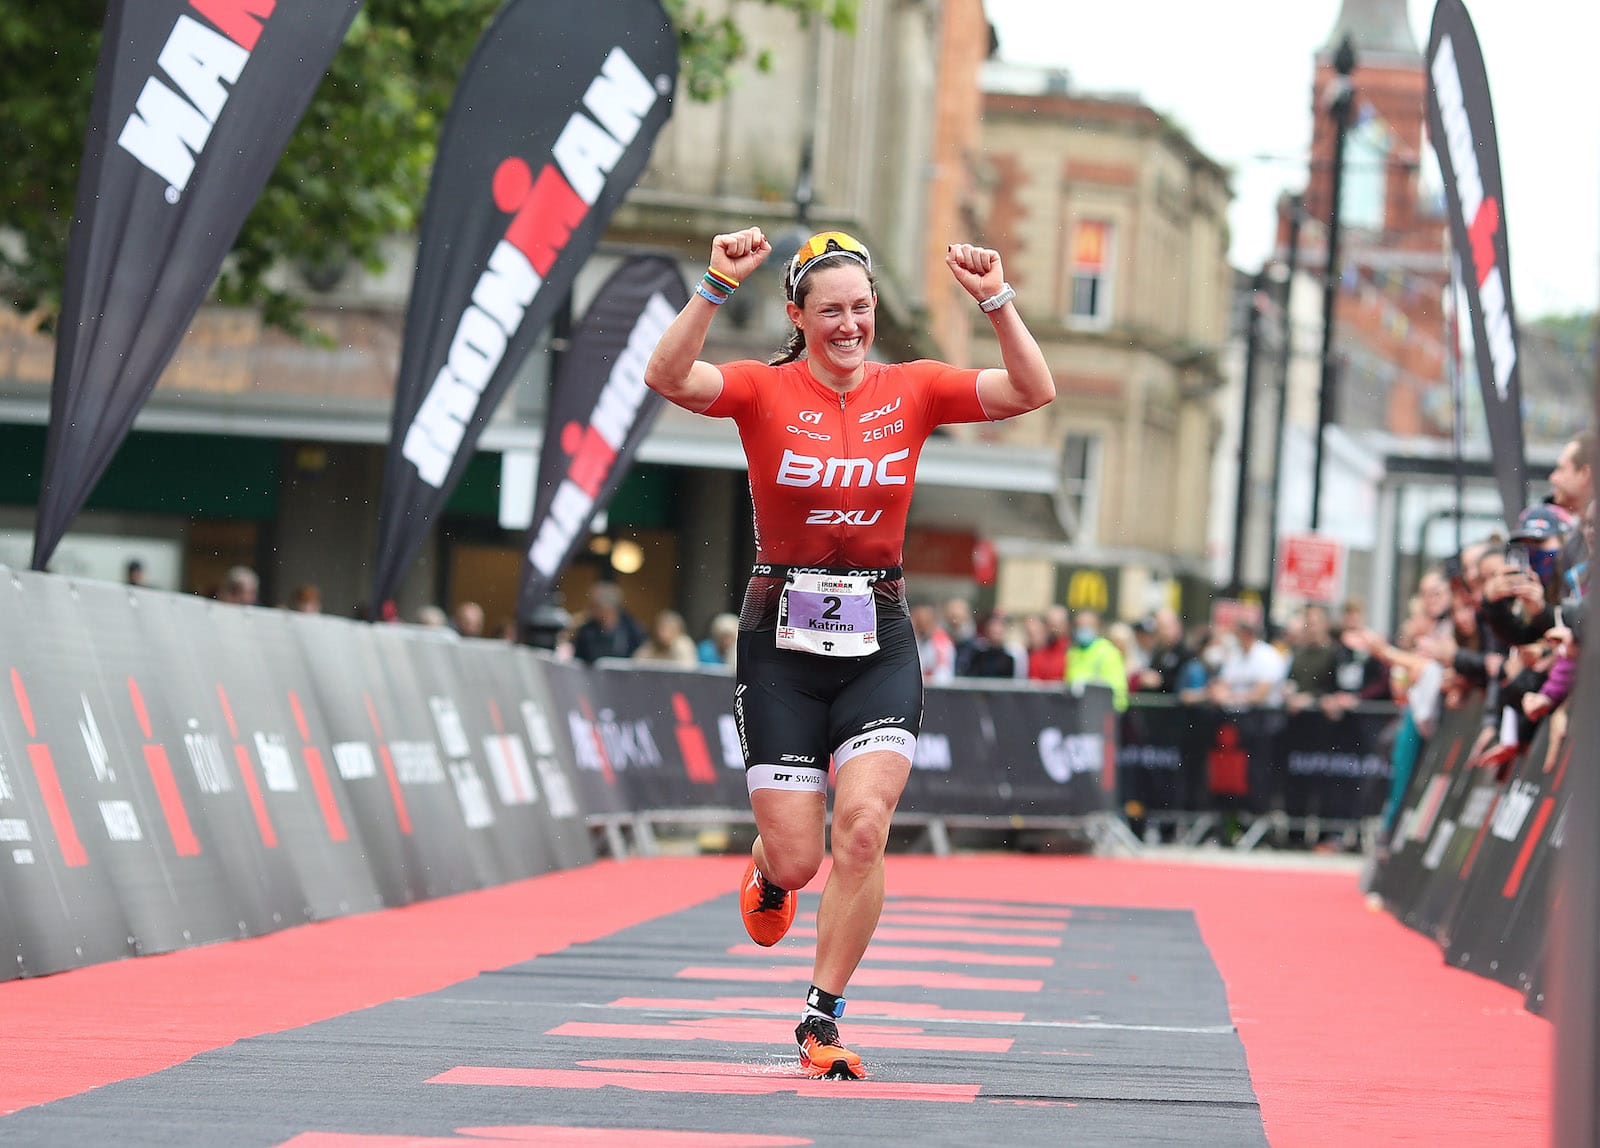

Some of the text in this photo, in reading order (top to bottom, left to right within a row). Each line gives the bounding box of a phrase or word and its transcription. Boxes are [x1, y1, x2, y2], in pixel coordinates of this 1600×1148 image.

[402, 46, 658, 488] IRONMAN
[776, 447, 909, 488] BMC
[821, 596, 842, 620] 2
[808, 618, 854, 632] Katrina
[852, 734, 906, 750] DT SWISS
[773, 773, 820, 784] DT SWISS
